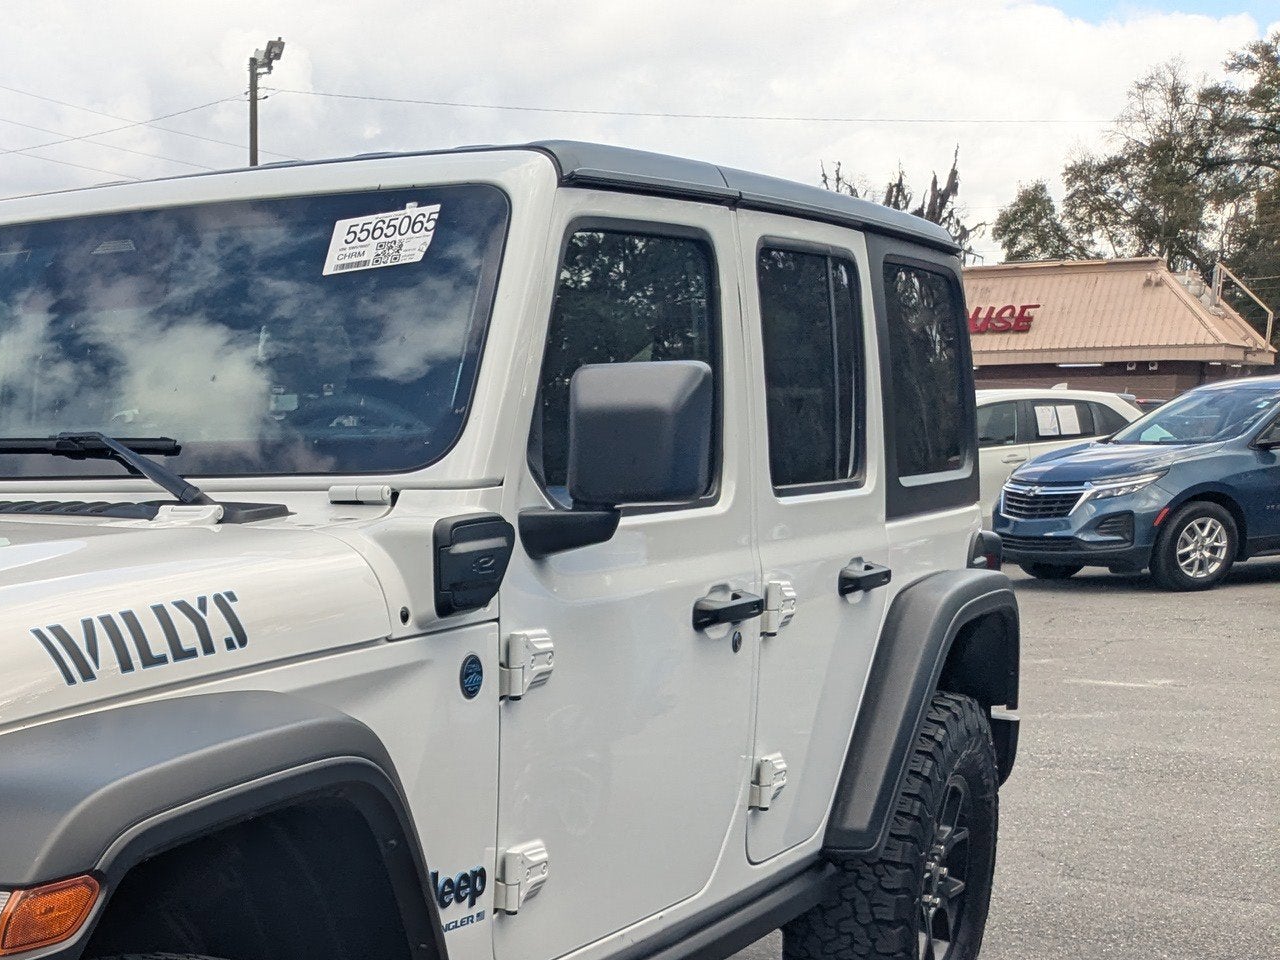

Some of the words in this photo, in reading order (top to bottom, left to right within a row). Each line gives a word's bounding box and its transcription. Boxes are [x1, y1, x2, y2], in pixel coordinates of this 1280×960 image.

[344, 211, 440, 245] 5565065
[336, 250, 366, 261] CHRM
[967, 304, 1041, 334] USE
[29, 590, 249, 687] WILLYS
[441, 914, 475, 933] NGLER
